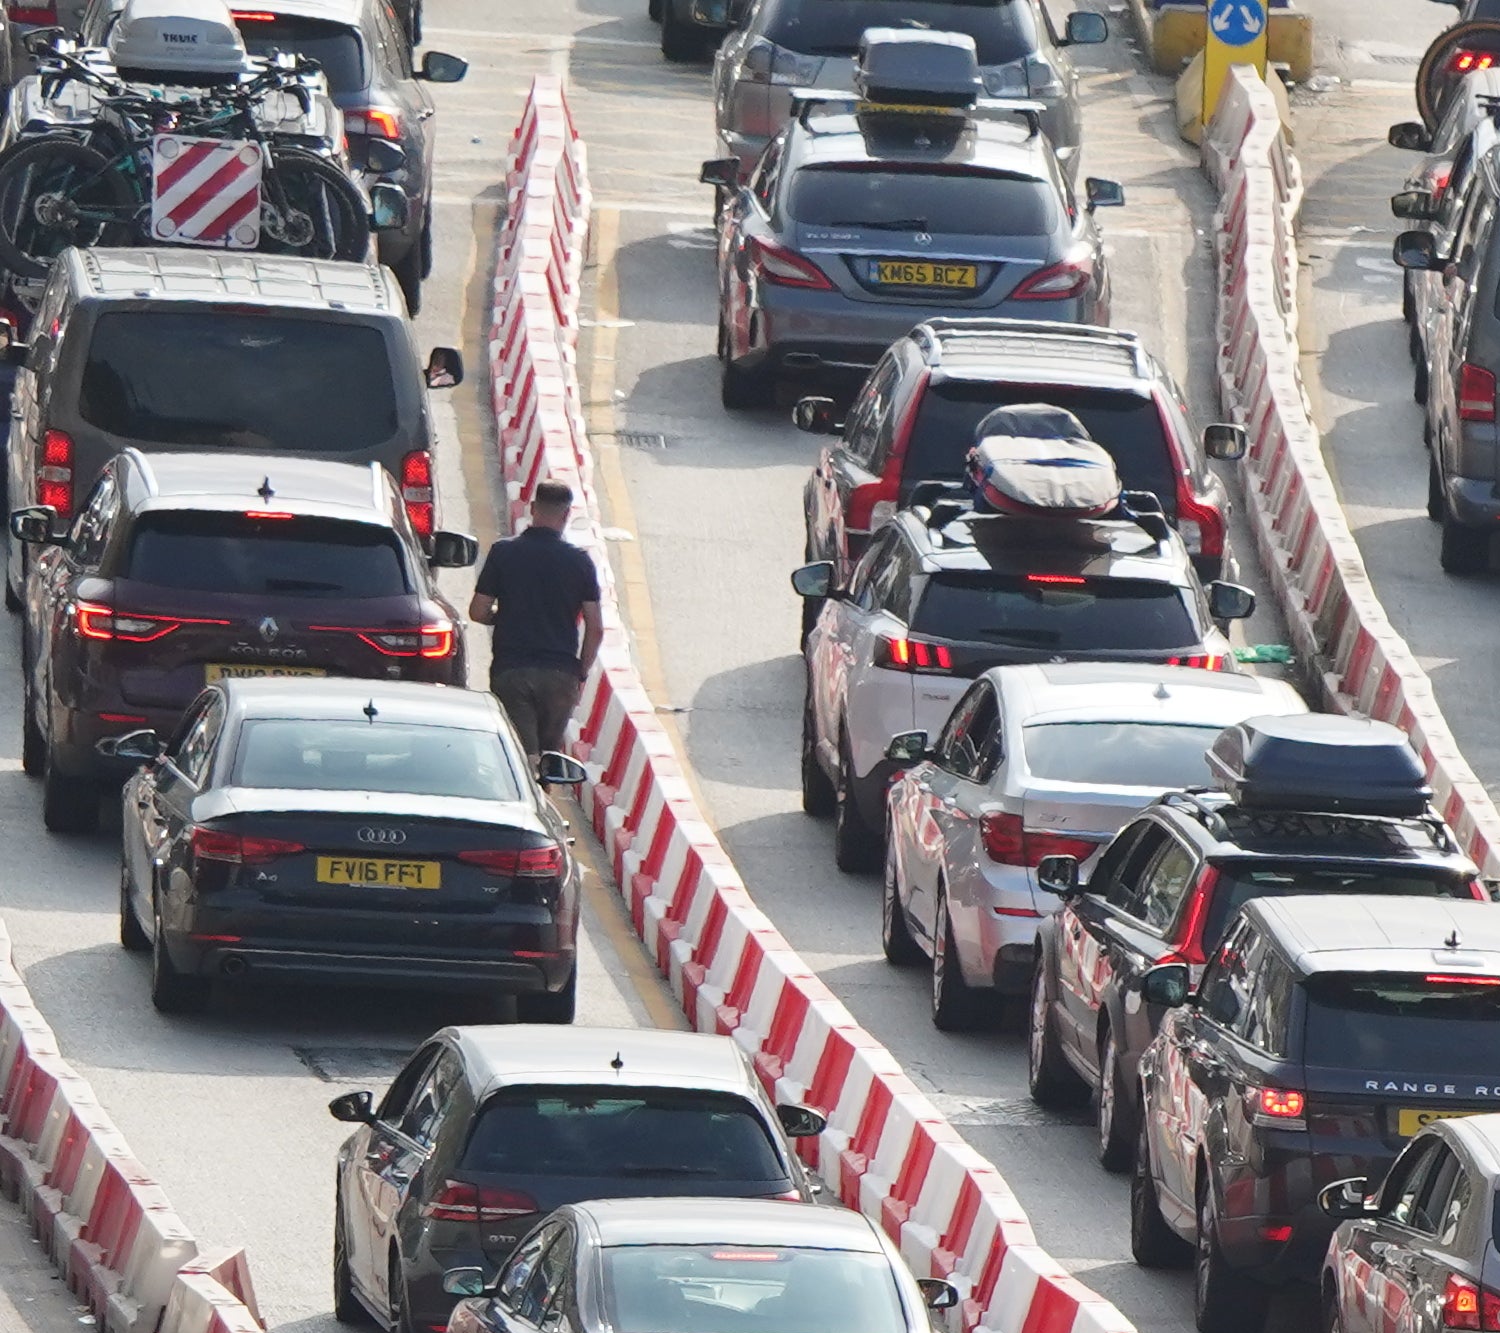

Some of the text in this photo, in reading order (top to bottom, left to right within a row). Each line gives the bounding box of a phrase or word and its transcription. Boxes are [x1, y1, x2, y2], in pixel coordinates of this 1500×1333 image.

[877, 262, 969, 285] KM65 BCZ
[330, 861, 427, 884] FV16 FFT
[1365, 1080, 1455, 1095] RANGE
